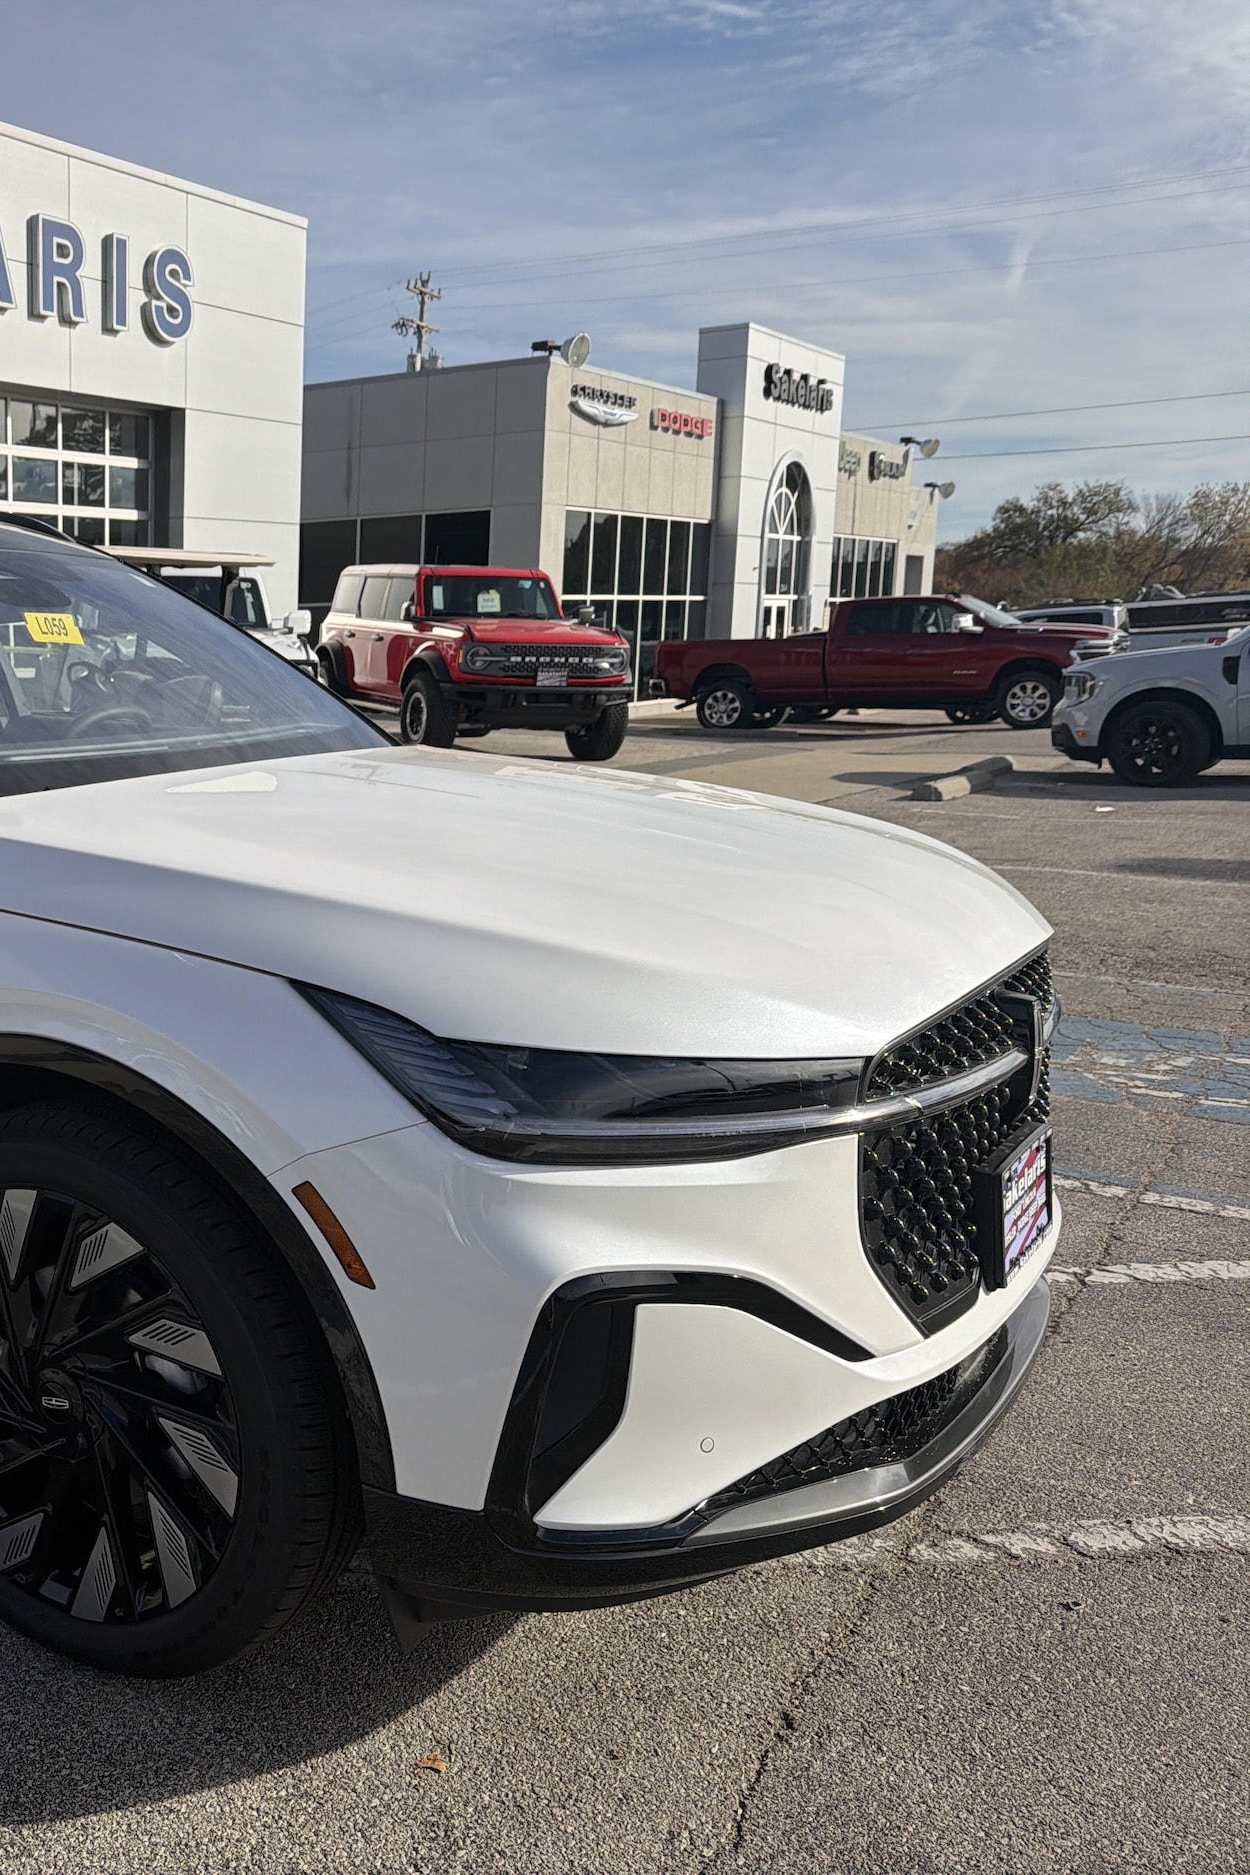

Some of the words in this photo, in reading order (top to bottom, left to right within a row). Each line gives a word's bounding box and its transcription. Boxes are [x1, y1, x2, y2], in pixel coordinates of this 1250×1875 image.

[765, 362, 833, 412] Sakelaris
[656, 408, 713, 437] DODGE
[35, 616, 69, 637] L059
